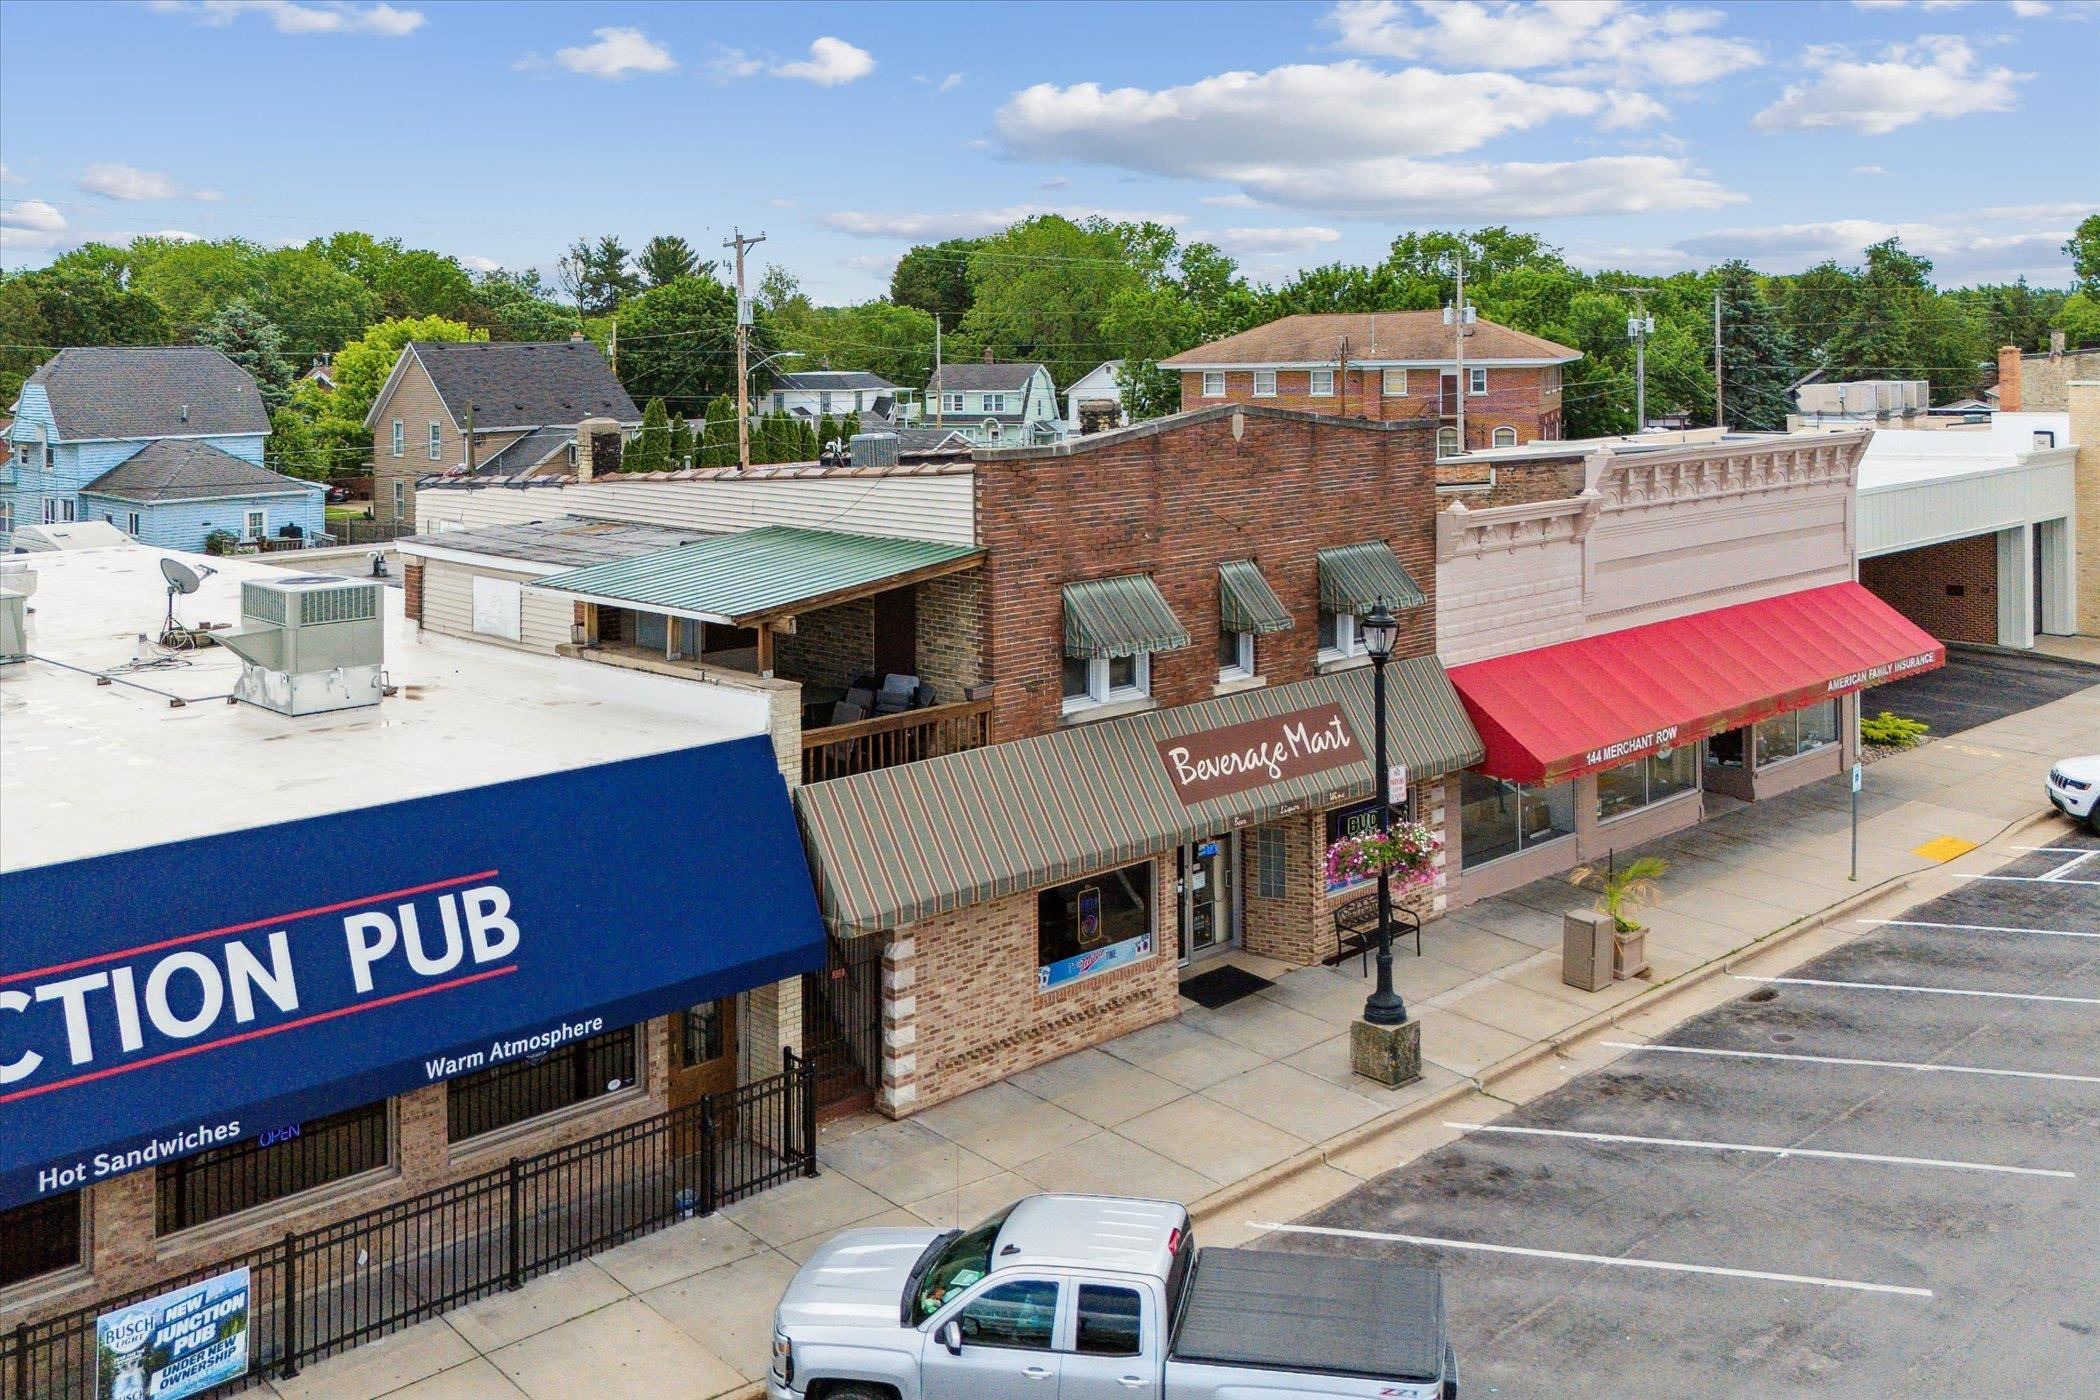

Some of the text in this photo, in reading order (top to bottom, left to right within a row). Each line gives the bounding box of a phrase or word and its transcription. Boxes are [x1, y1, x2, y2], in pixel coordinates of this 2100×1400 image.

[1828, 652, 1934, 691] AMERICAN FAMILY INSURANCE
[1168, 715, 1350, 785] Beverage Mart
[1586, 726, 1677, 765] 144 MERCHANT ROW
[1280, 804, 1300, 815] Liquor
[344, 885, 520, 994] PUB
[425, 1051, 484, 1079] Warm
[489, 1017, 603, 1062] Atmosphere
[259, 1123, 300, 1147] OPEN
[39, 1120, 240, 1192] Hot Sandwiches
[154, 1291, 246, 1348] JUNCTION
[166, 1293, 205, 1322] NEW
[105, 1316, 154, 1344] BUSCH
[116, 1332, 144, 1348] LIGHT
[173, 1323, 216, 1356] PUB
[160, 1346, 237, 1390] OWNERSHIP
[162, 1350, 206, 1378] UNDER
[207, 1335, 236, 1356] NEW
